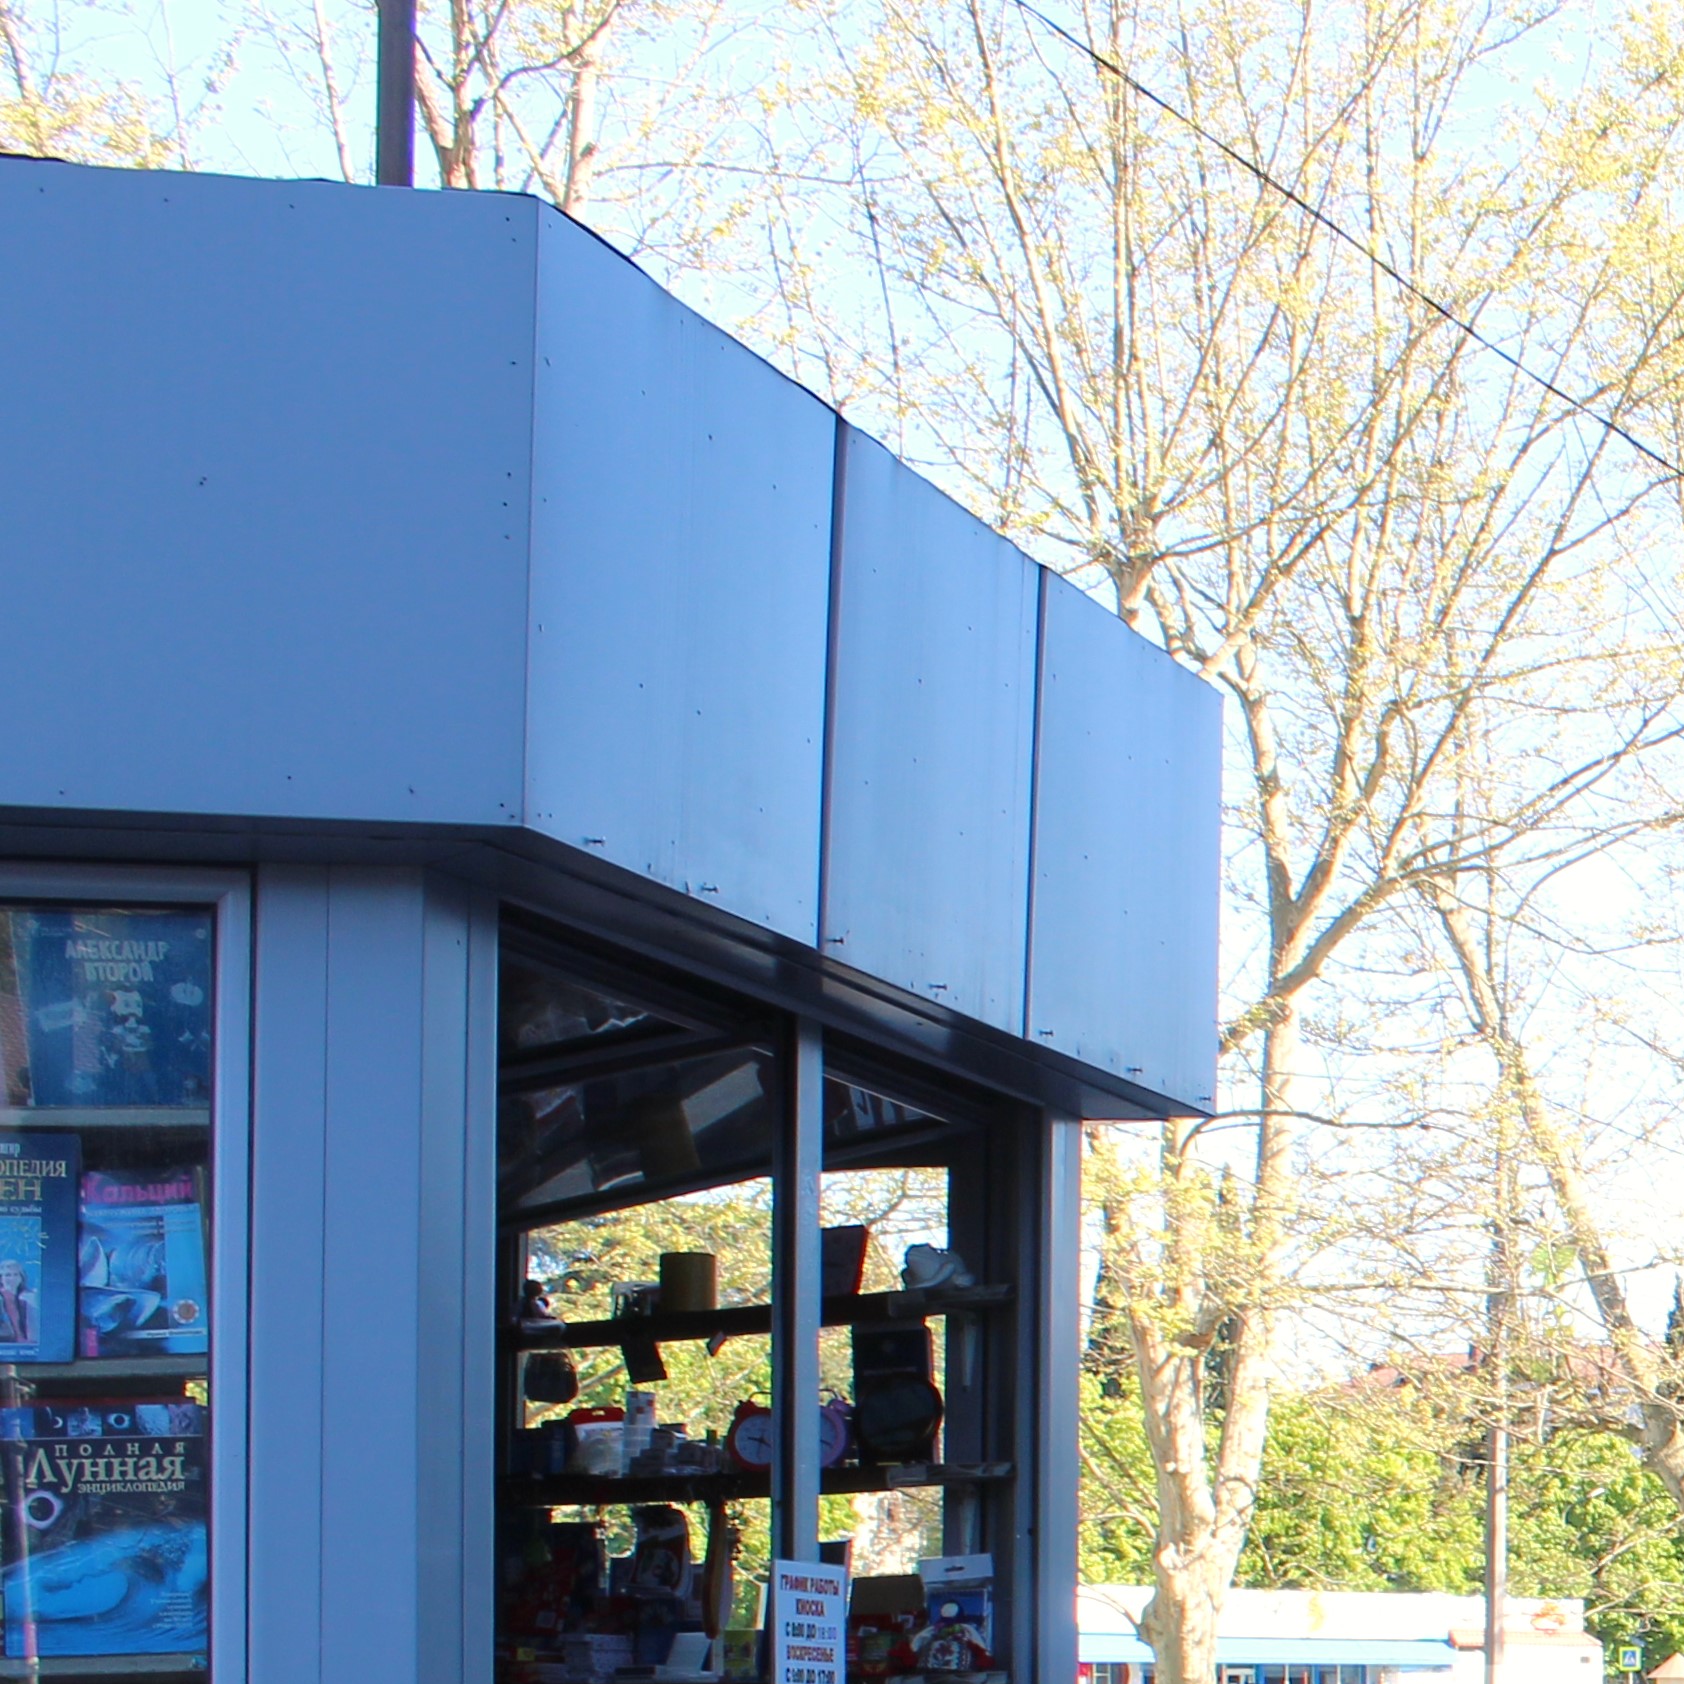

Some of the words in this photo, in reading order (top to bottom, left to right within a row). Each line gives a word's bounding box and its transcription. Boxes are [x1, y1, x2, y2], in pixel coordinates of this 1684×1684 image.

[64, 939, 171, 962] АЛЕКСАНДР
[84, 961, 154, 982] ВТОРОЙ
[83, 1173, 193, 1205] Кальций
[54, 1442, 186, 1457] ПОЛНАЯ
[26, 1448, 186, 1494] Лунная
[77, 1480, 186, 1496] ЭНЦИКЛОПЕДИЯ
[810, 1575, 840, 1597] РАБОТЫ
[795, 1598, 826, 1617] КИОСКА
[806, 1624, 817, 1642] ДО
[786, 1644, 835, 1663] ВОСКРЕСЕНЬЕ
